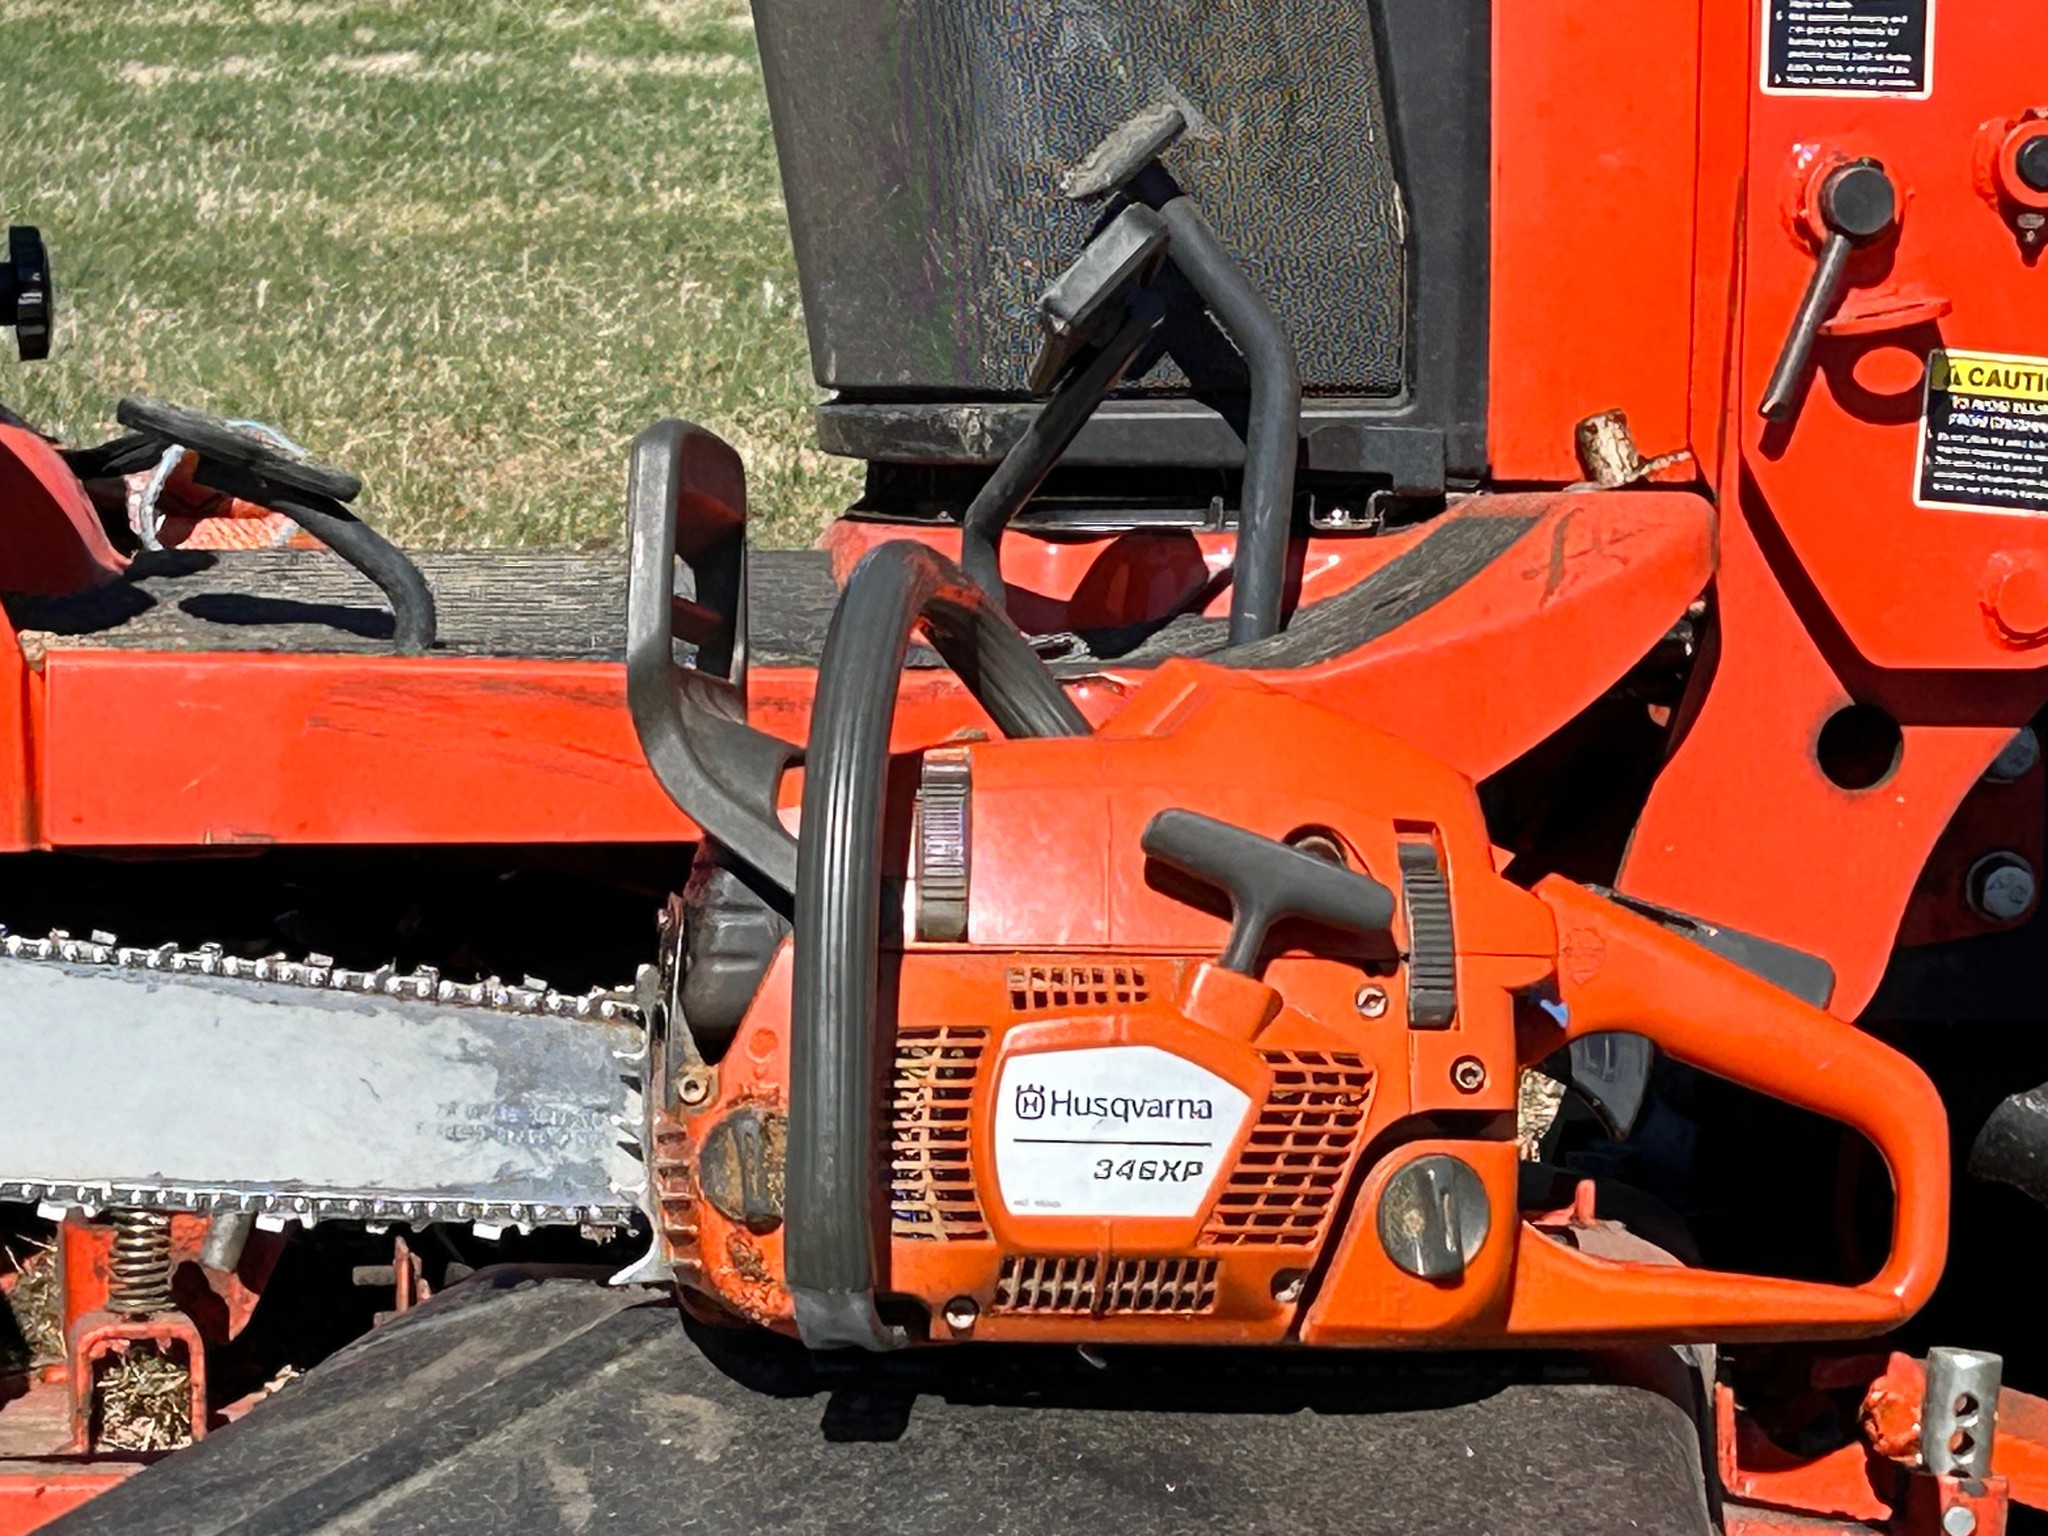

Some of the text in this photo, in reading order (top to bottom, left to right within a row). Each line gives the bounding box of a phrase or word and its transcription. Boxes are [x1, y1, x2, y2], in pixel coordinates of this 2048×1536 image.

[1968, 367, 2048, 393] CAUTI
[1051, 1090, 1213, 1123] Husqvarna
[1094, 1159, 1204, 1182] 346XP
